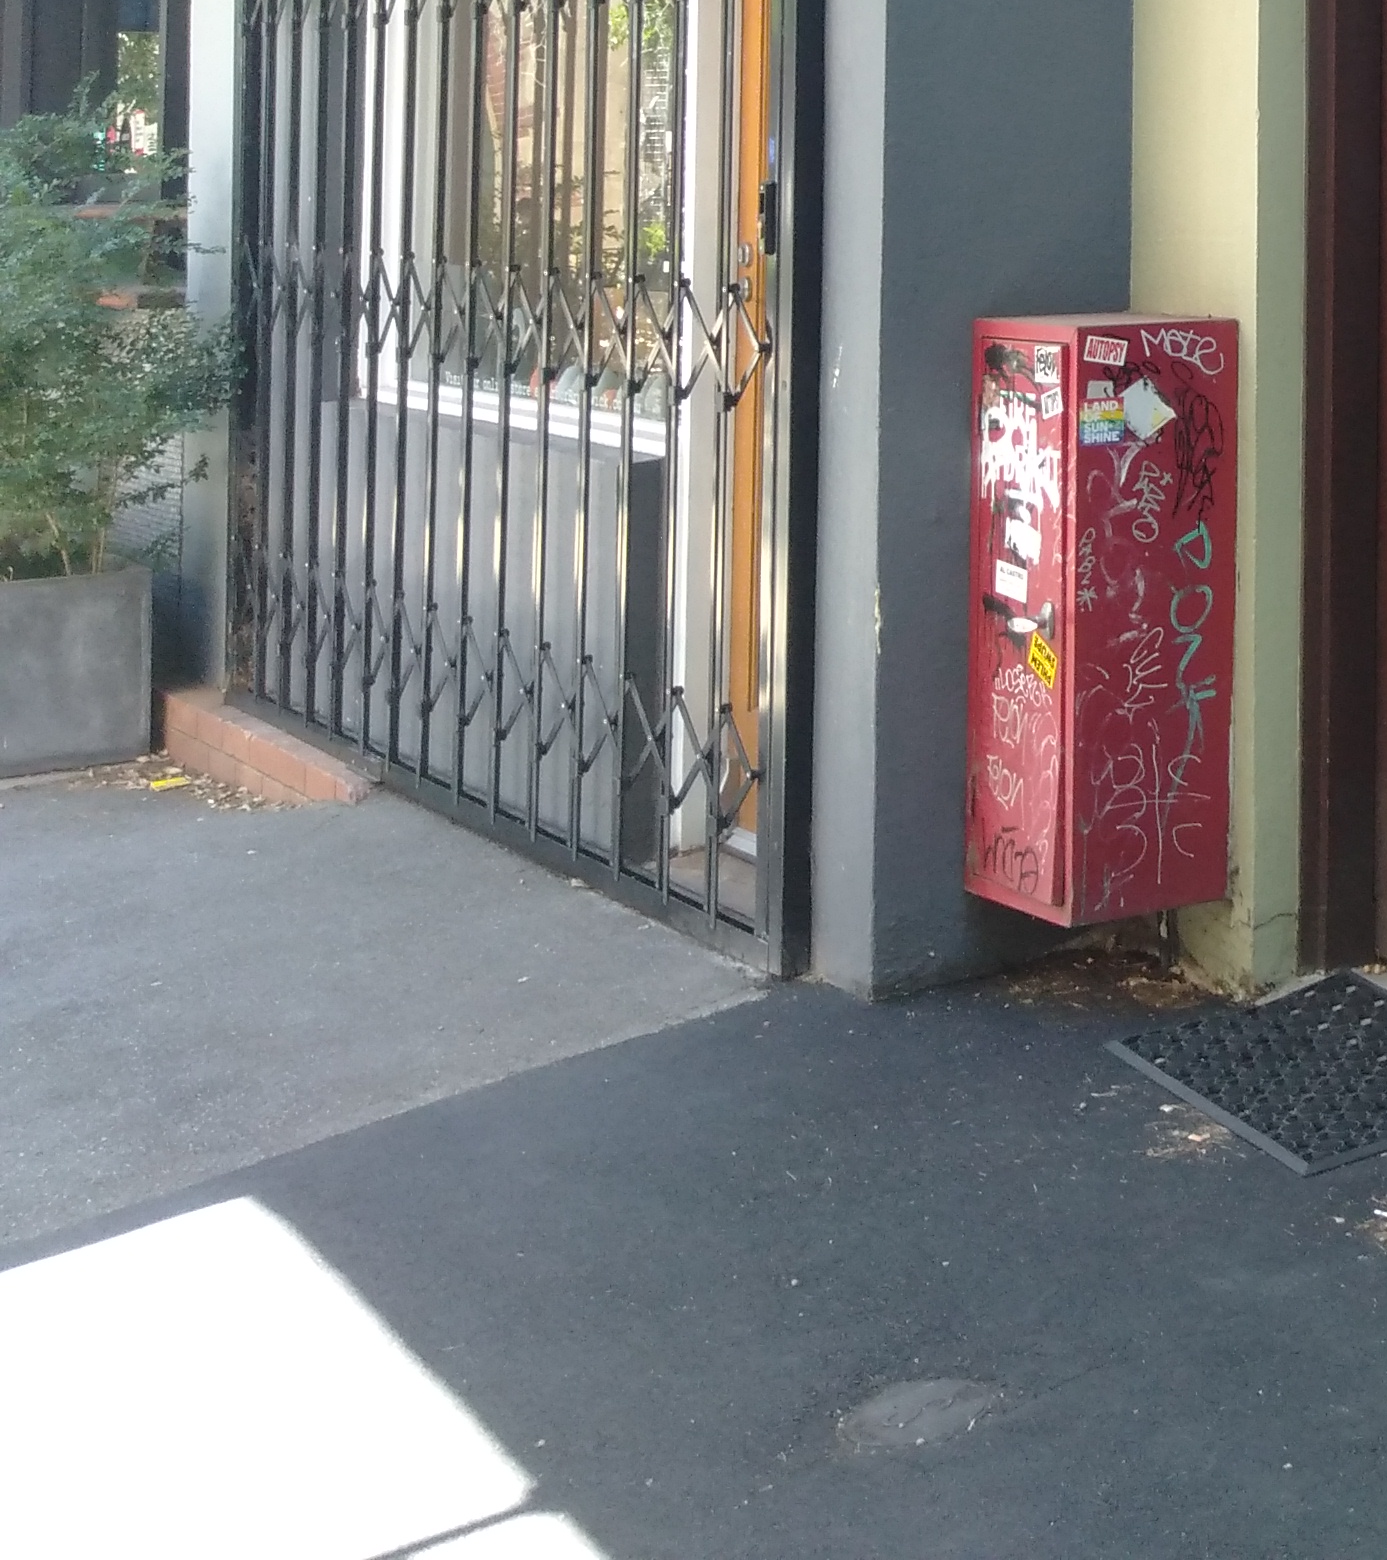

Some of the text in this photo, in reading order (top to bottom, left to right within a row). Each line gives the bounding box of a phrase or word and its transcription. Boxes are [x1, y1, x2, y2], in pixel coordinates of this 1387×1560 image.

[1086, 338, 1126, 363] AUTOPSY
[1083, 400, 1119, 412] LAND
[1084, 431, 1120, 444] SHINE
